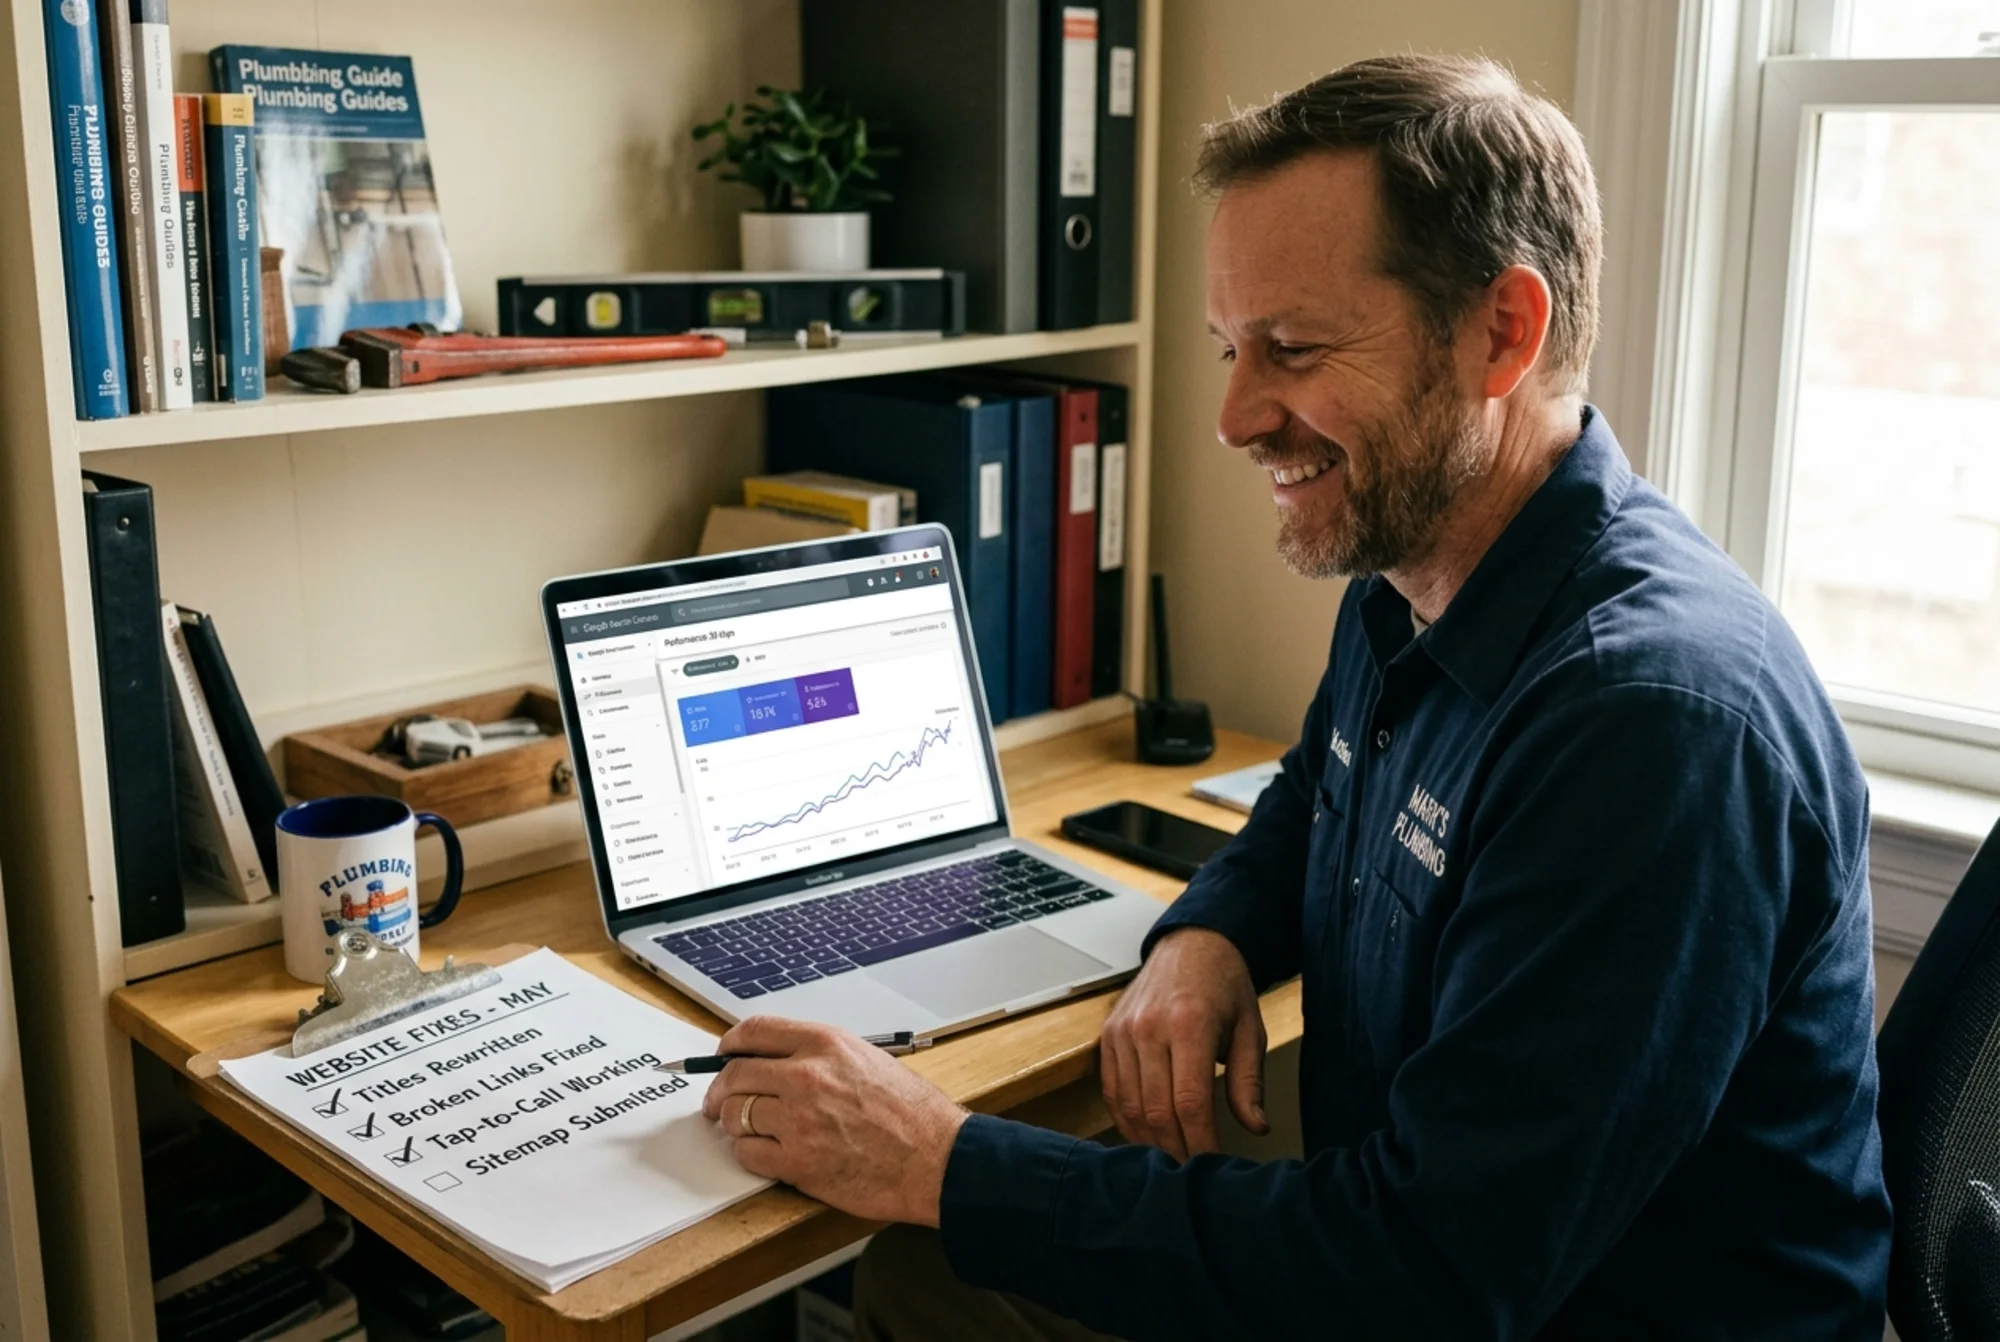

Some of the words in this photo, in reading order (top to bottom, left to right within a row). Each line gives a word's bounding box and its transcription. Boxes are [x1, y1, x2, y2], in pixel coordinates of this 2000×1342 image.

[242, 84, 338, 113] Plumbing
[341, 88, 408, 112] Guides
[347, 65, 404, 88] Guide
[1408, 783, 1450, 839] MARK'S
[319, 858, 413, 897] PLUMBING
[285, 1036, 408, 1087] WEBSITE
[407, 1009, 481, 1042] FIXES
[498, 982, 553, 1009] MAY
[351, 1072, 427, 1103] Titles
[426, 1028, 543, 1076] Rewritten
[388, 1088, 481, 1127] Broken
[477, 1061, 545, 1092] Links
[541, 1035, 607, 1066] Fixed
[425, 1087, 566, 1150] Tap-to-Call
[560, 1053, 662, 1093] Working
[466, 1127, 570, 1176] Sitemap
[568, 1074, 690, 1131] Submitted
